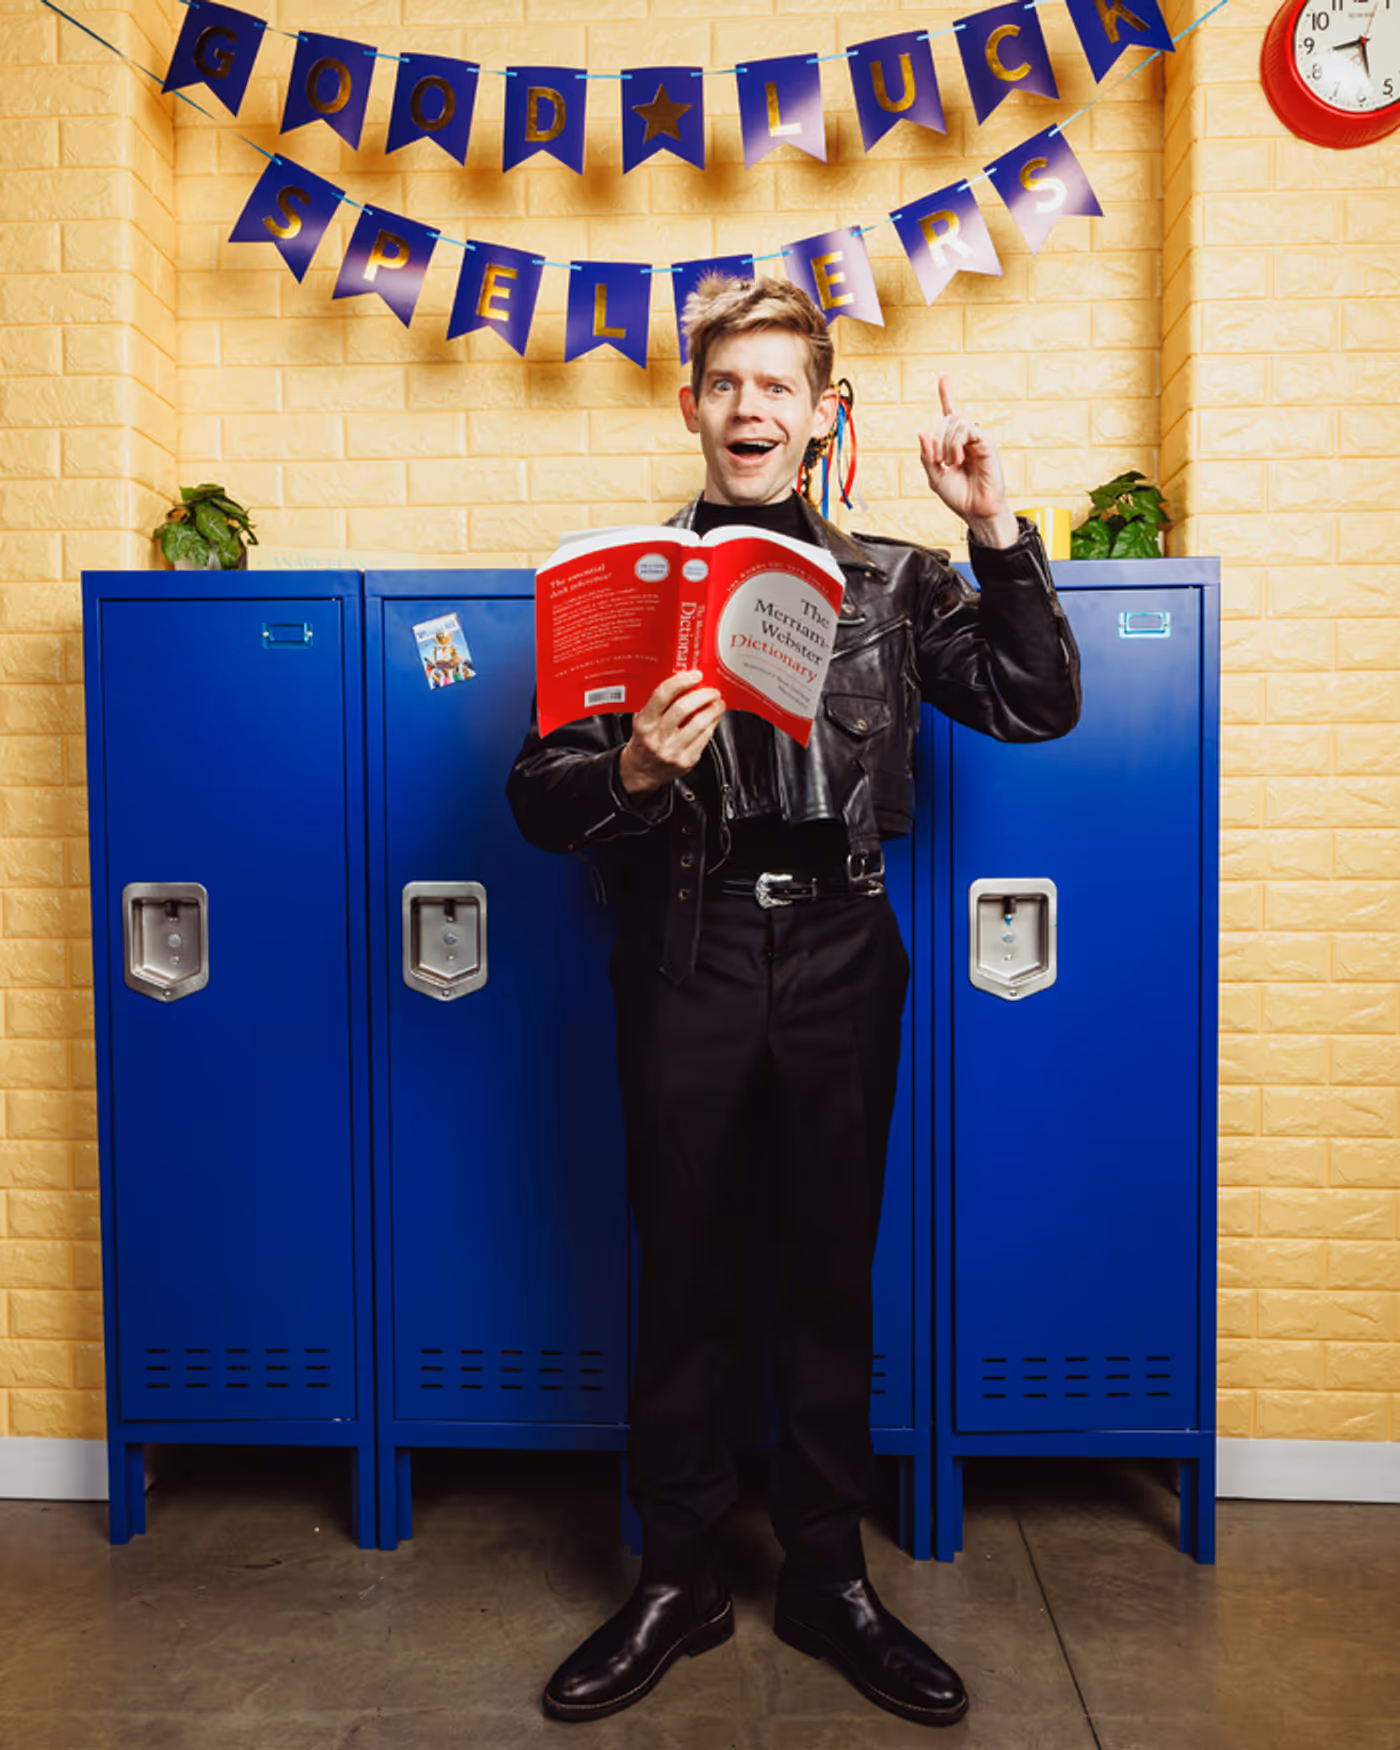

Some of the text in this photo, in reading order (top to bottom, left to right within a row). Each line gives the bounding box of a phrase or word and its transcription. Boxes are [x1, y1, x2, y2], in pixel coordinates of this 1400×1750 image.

[1312, 12, 1329, 31] 10
[1304, 37, 1315, 55] 9
[193, 0, 1152, 143] GOOD LUCK
[1312, 63, 1322, 80] 8
[1382, 78, 1393, 96] 5
[262, 157, 1069, 339] SPELERS
[673, 601, 697, 673] Dictionar
[754, 598, 829, 650] Merriam-
[801, 598, 830, 630] The
[730, 633, 818, 683] Dictionary
[761, 619, 824, 666] Webster
